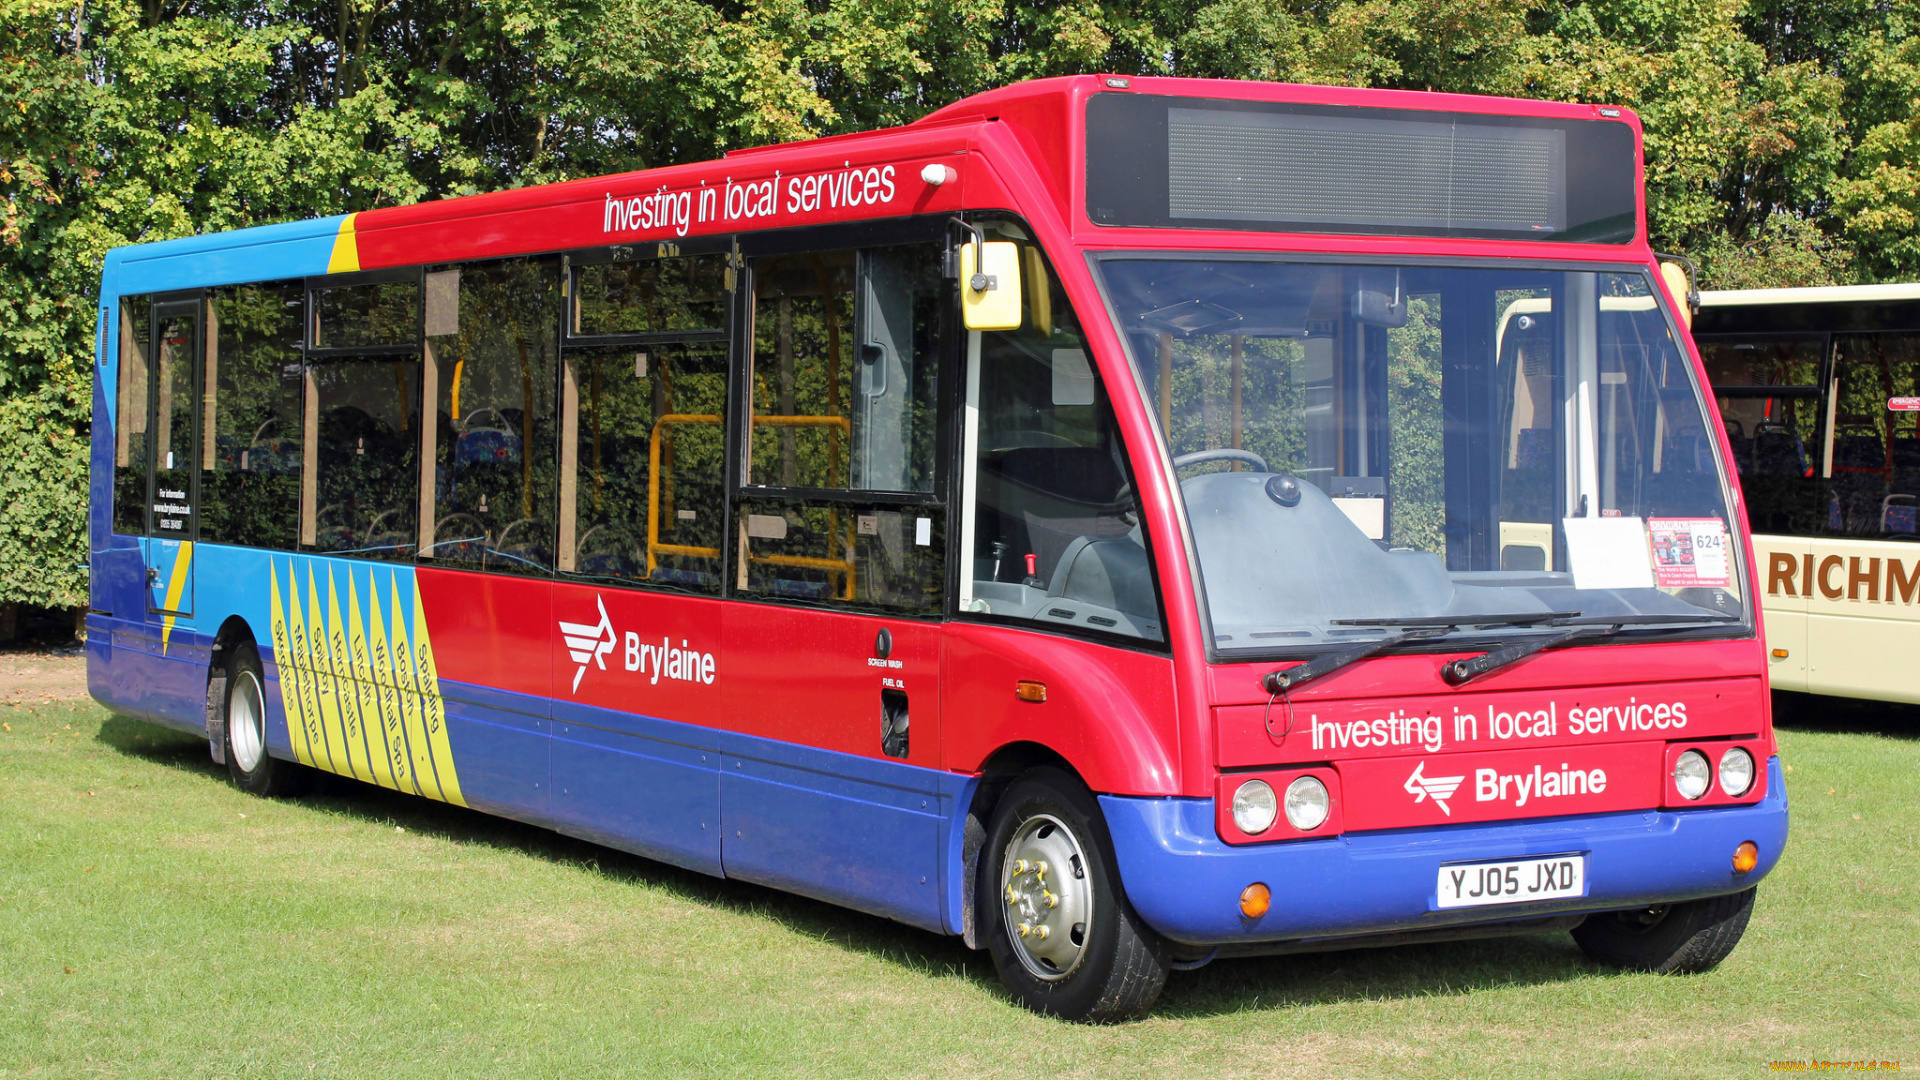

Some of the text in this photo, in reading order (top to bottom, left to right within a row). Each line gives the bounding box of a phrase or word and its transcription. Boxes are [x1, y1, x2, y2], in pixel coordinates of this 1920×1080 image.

[603, 160, 896, 237] Investing in local services
[1696, 535, 1721, 548] 624
[275, 620, 294, 711] Skegness
[295, 623, 319, 745] Mablethorpe
[333, 631, 356, 738] Horncastle
[353, 634, 372, 707] Lincoln
[396, 641, 415, 716] Boston
[419, 643, 439, 734] Spalding
[625, 631, 716, 685] Brylaine
[867, 658, 903, 669] SCREEN WASH
[882, 678, 905, 688] FUEL OIL
[376, 638, 405, 778] Woodhall Spa
[1311, 697, 1688, 752] Investing in local services
[1475, 762, 1607, 807] Brylaine
[1450, 861, 1574, 899] YJ05 JXD
